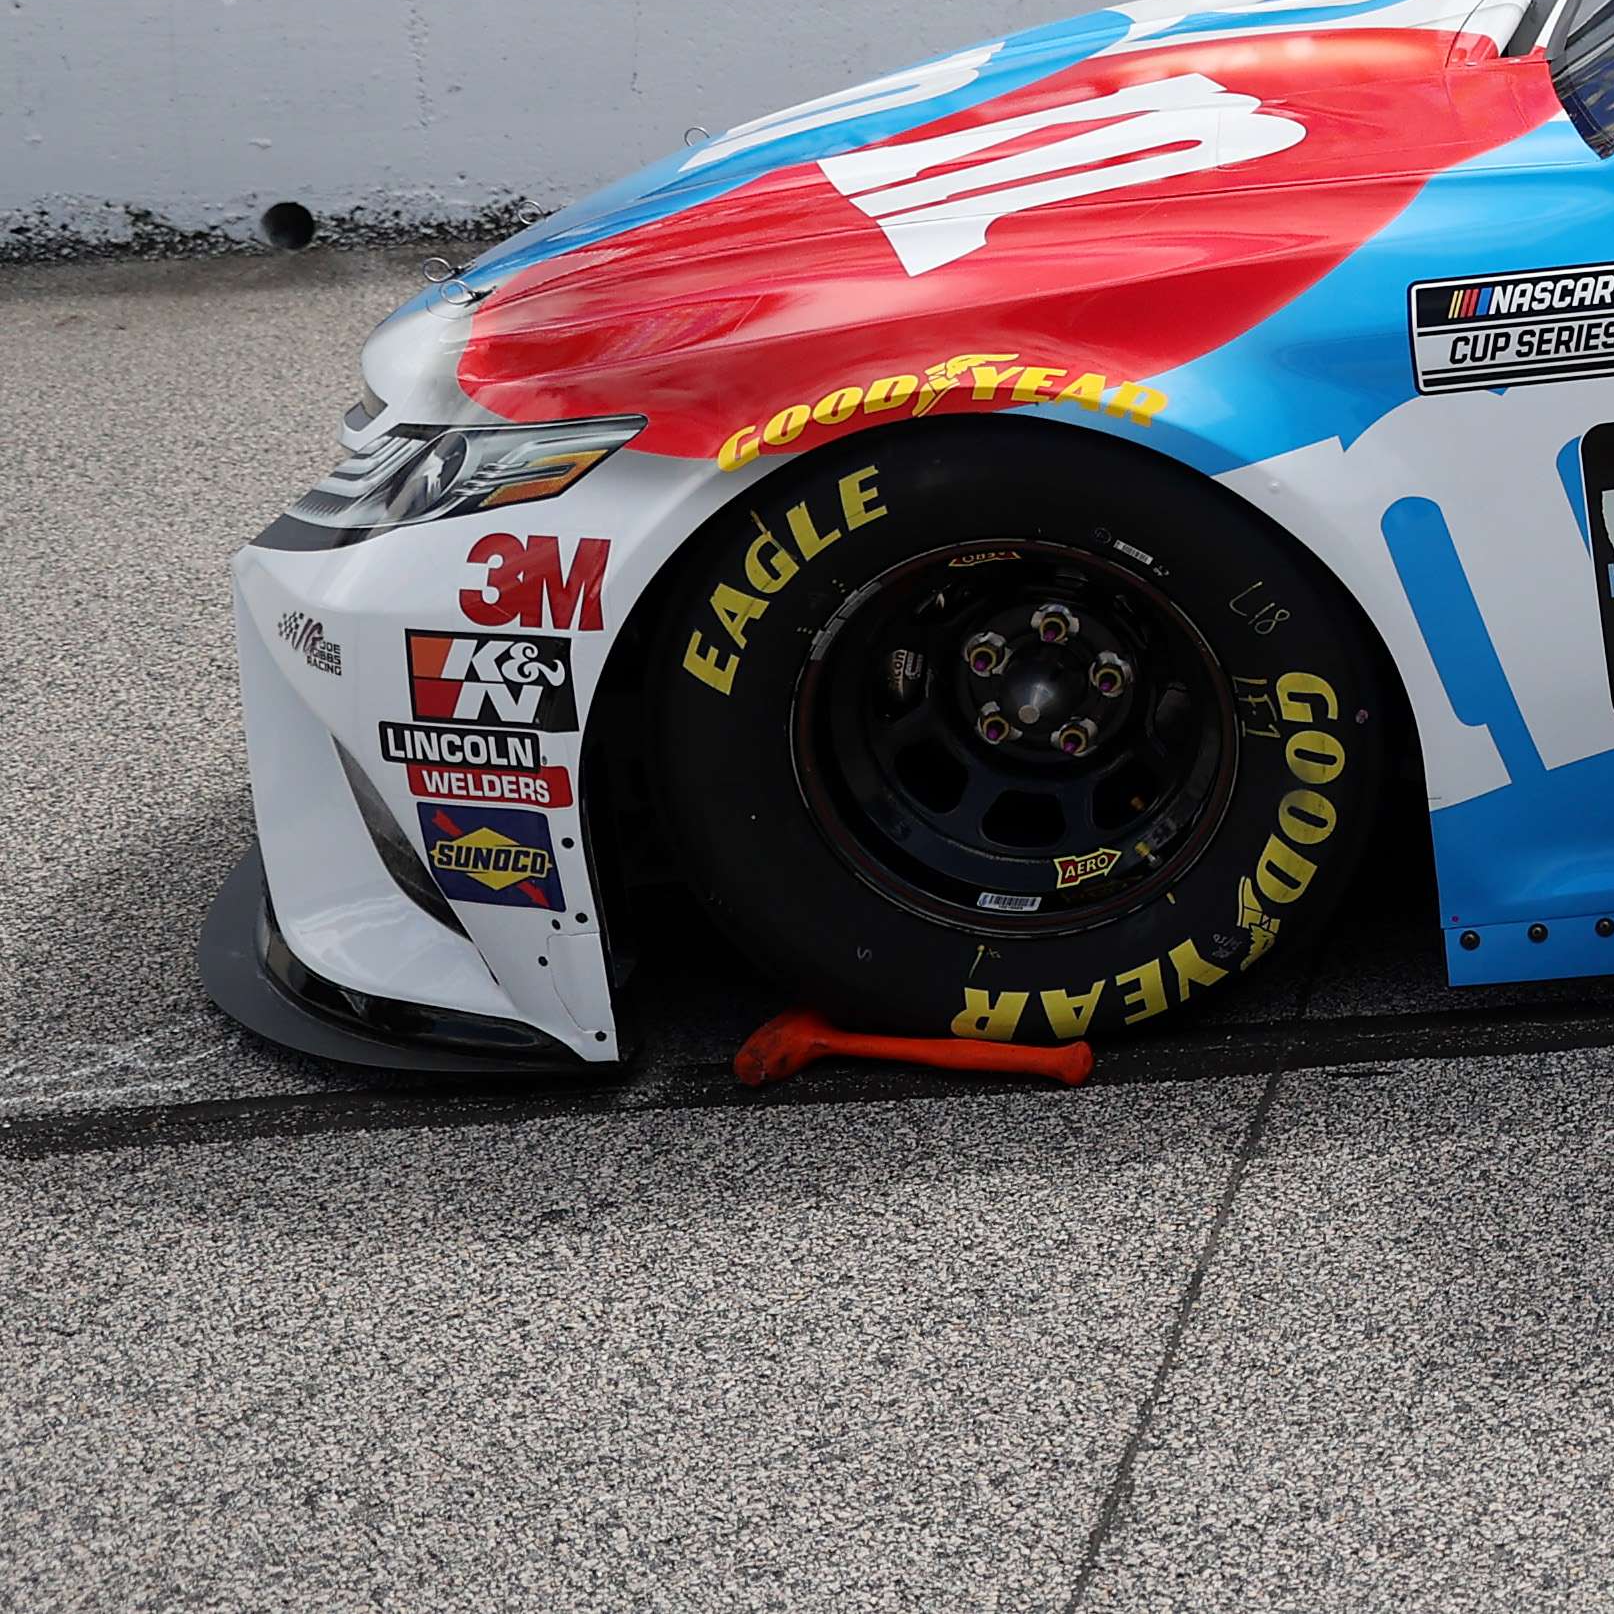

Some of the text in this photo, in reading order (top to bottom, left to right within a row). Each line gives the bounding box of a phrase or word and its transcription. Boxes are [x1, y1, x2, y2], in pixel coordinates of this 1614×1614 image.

[1449, 328, 1511, 366] CUP
[716, 353, 1169, 473] GOODYEAR
[459, 532, 611, 632] 3M
[682, 463, 889, 696] EAGLE
[1229, 580, 1291, 635] L18
[306, 655, 342, 676] RACING
[386, 727, 535, 768] LINCOLN
[424, 770, 552, 804] WELDERS
[436, 843, 549, 876] SUNOCO
[1064, 854, 1110, 880] AERO
